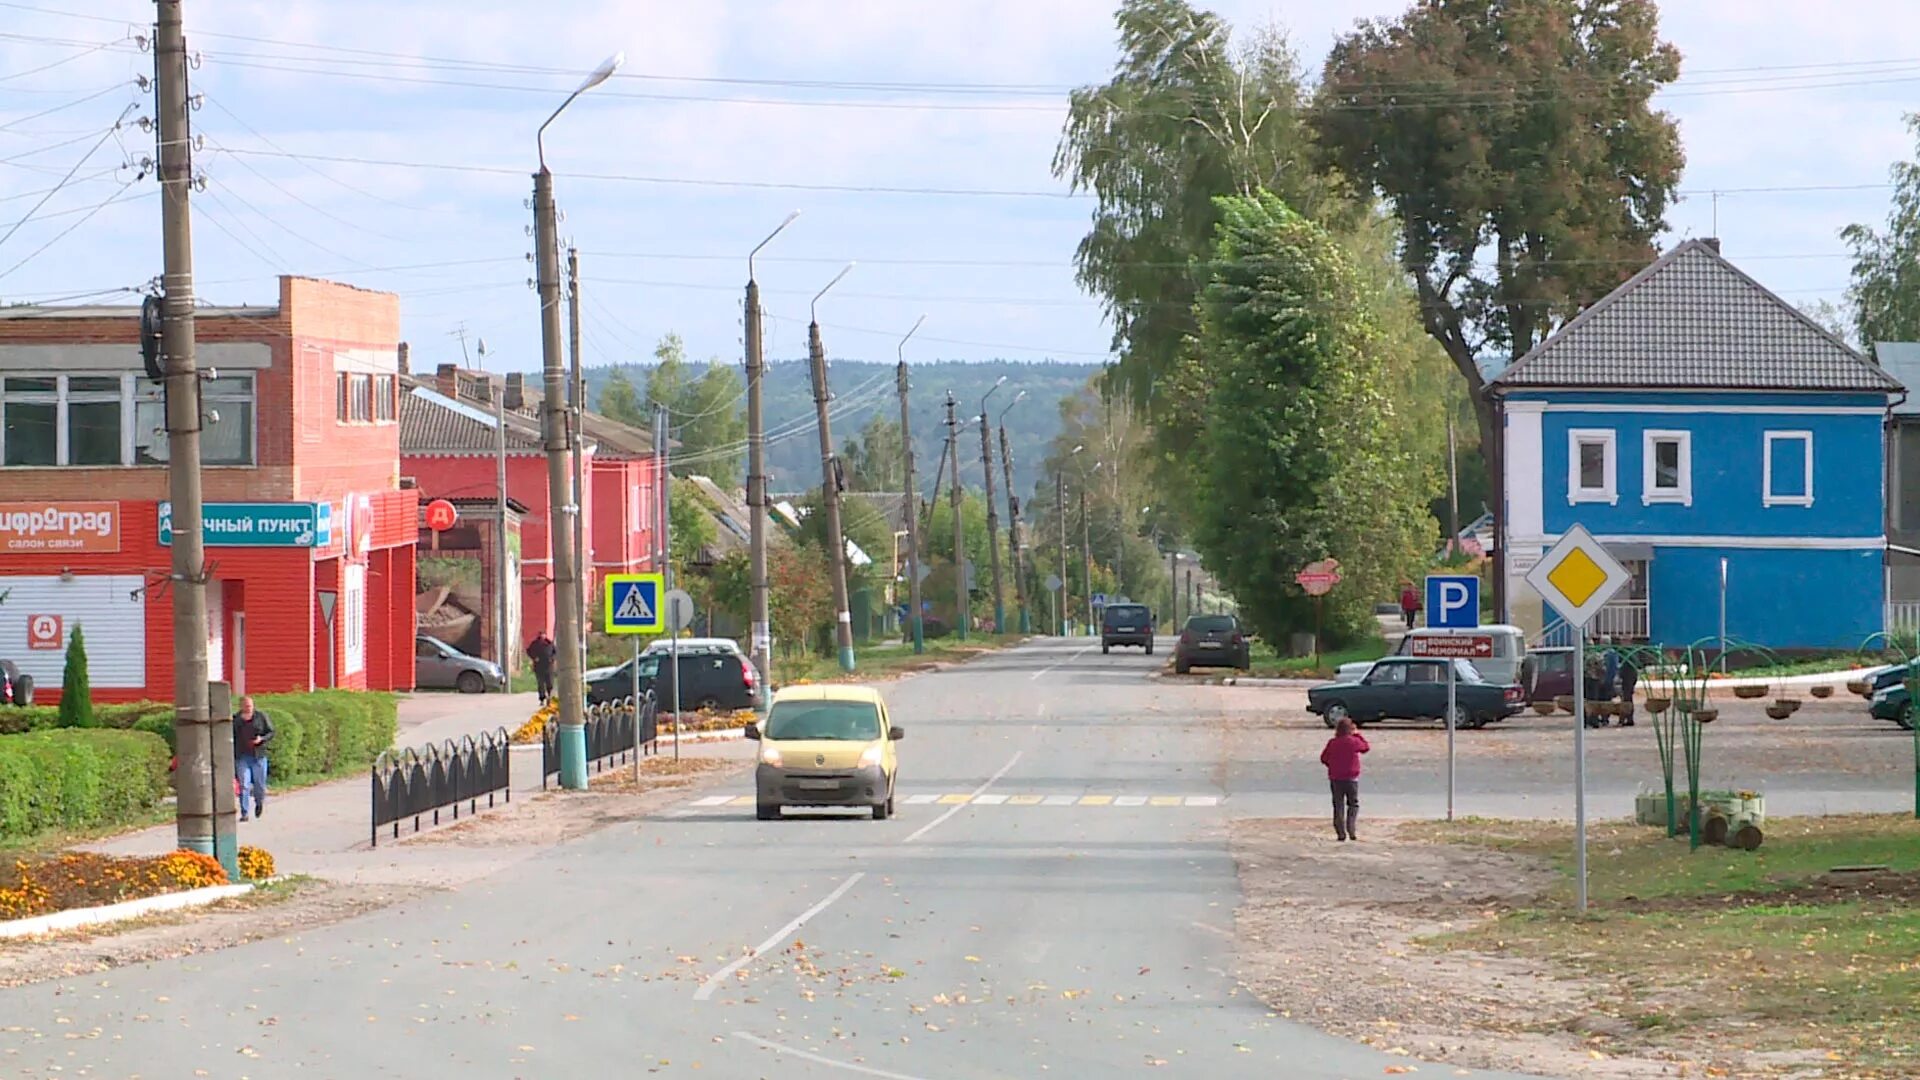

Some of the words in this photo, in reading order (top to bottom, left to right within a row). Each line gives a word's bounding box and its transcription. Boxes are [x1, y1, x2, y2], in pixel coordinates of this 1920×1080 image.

[160, 516, 253, 533] АЧНЫЙ
[258, 518, 311, 533] ПУНКТ
[8, 539, 45, 549] салон
[47, 539, 84, 549] связи
[1440, 581, 1469, 624] P
[1427, 636, 1473, 646] ВОИНСКИЙ
[1427, 646, 1477, 656] МЕМОРИАЛ
